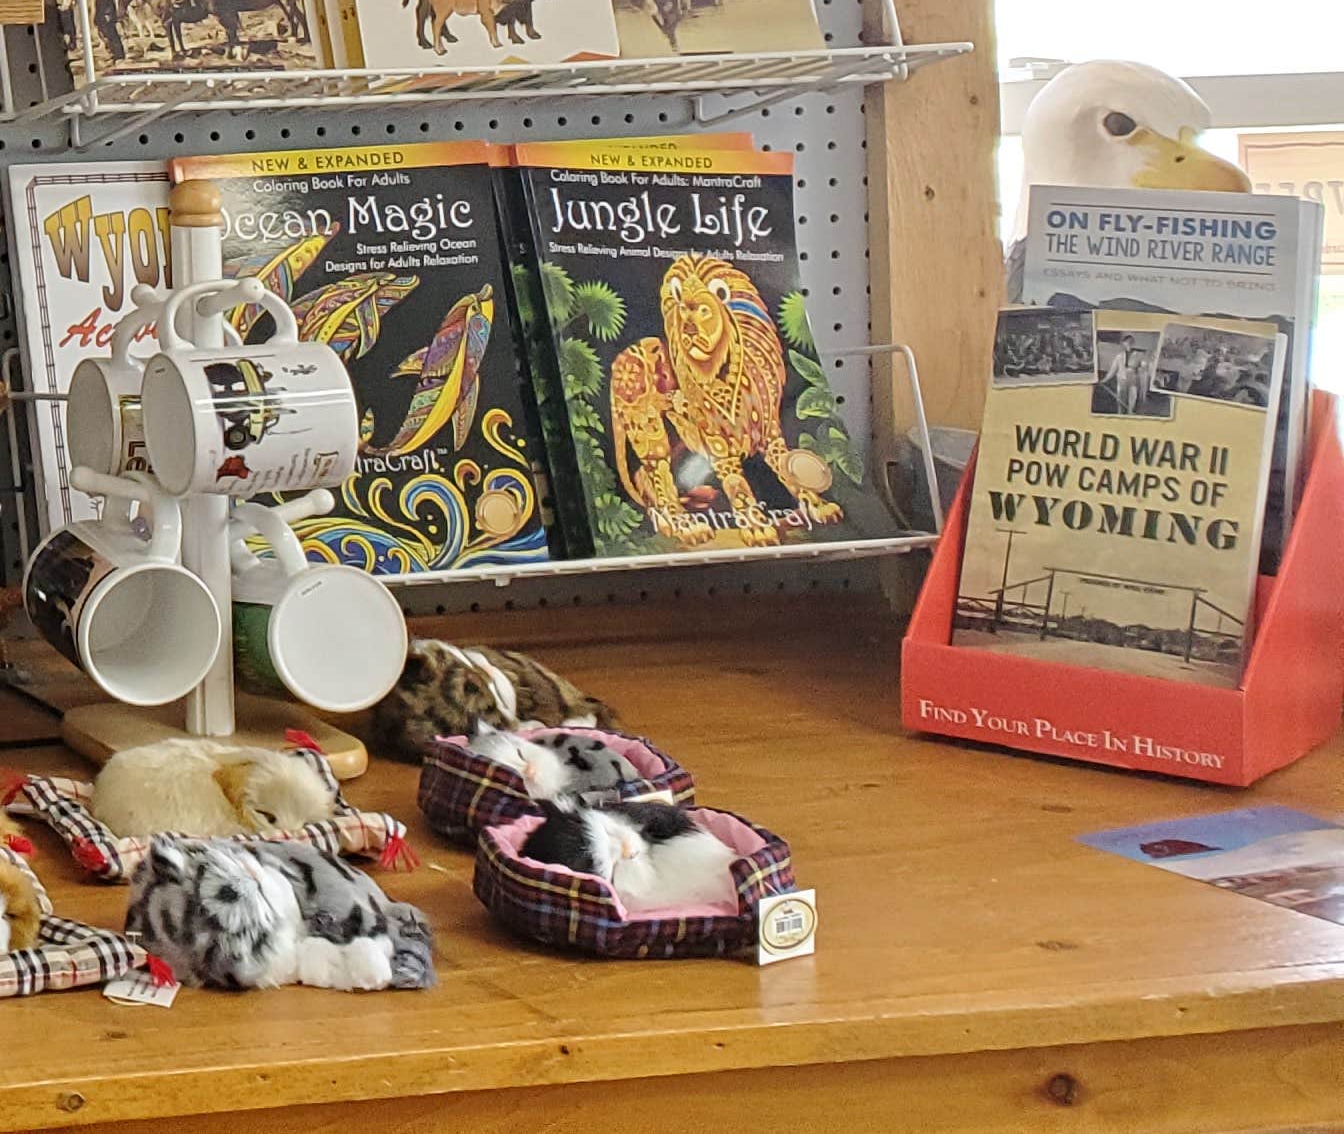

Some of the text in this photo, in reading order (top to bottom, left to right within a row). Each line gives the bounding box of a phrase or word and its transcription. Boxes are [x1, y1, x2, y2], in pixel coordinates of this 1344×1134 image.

[251, 151, 404, 173] NEW & EXPANDED
[590, 154, 713, 169] NEW & EXPANDED
[252, 172, 411, 194] Coloring Book For Adults
[550, 169, 762, 189] Coloring Book For Adults: MantraCraft
[348, 193, 474, 241] Magic
[549, 187, 773, 246] Jungle Life
[1045, 209, 1277, 241] ON FLY-FISHING
[356, 237, 477, 255] Stress Relieving Ocean
[549, 242, 576, 254] Stress
[578, 242, 618, 257] Relieving
[619, 245, 650, 258] Animal
[652, 247, 688, 261] Designs
[736, 249, 784, 263] Relaxation
[1045, 233, 1276, 267] THE WIND RIVER RANGE
[325, 252, 479, 274] Designs for Adults Relaxation
[1042, 269, 1276, 291] ESSAYS AND WHAT NOT TO BRING
[1014, 424, 1229, 476] WORLD WAR II
[1006, 458, 1229, 507] POW CAMPS OF
[988, 490, 1240, 551] WYOMING
[919, 699, 1225, 770] FIND YOUR PLACE IN HISTORY
